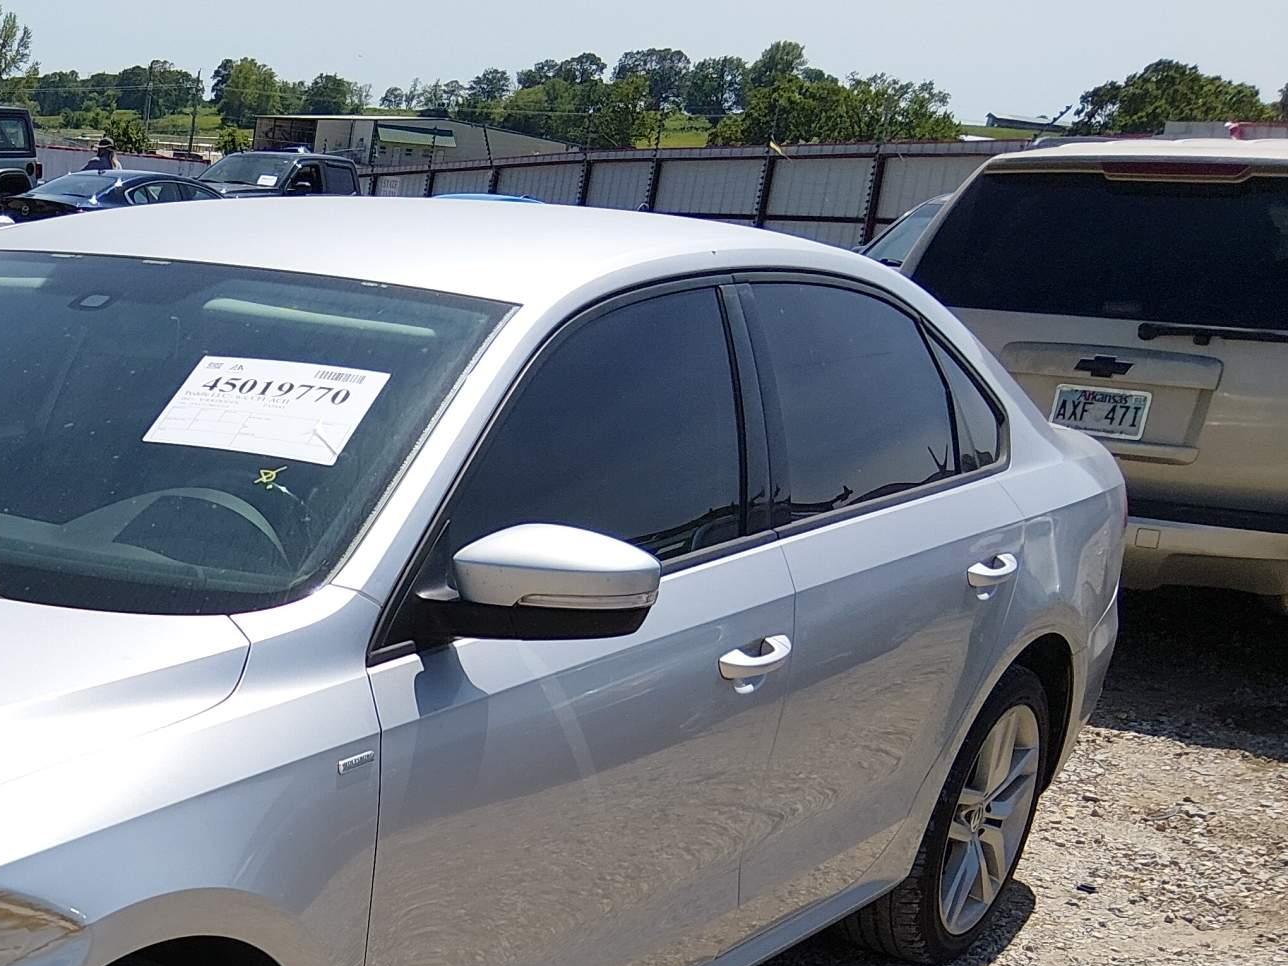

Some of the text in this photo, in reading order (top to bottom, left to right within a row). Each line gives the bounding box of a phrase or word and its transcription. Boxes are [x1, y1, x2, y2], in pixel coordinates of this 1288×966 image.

[201, 375, 352, 406] 45019770
[1077, 389, 1129, 404] Arkansas
[1056, 399, 1095, 422] AXF
